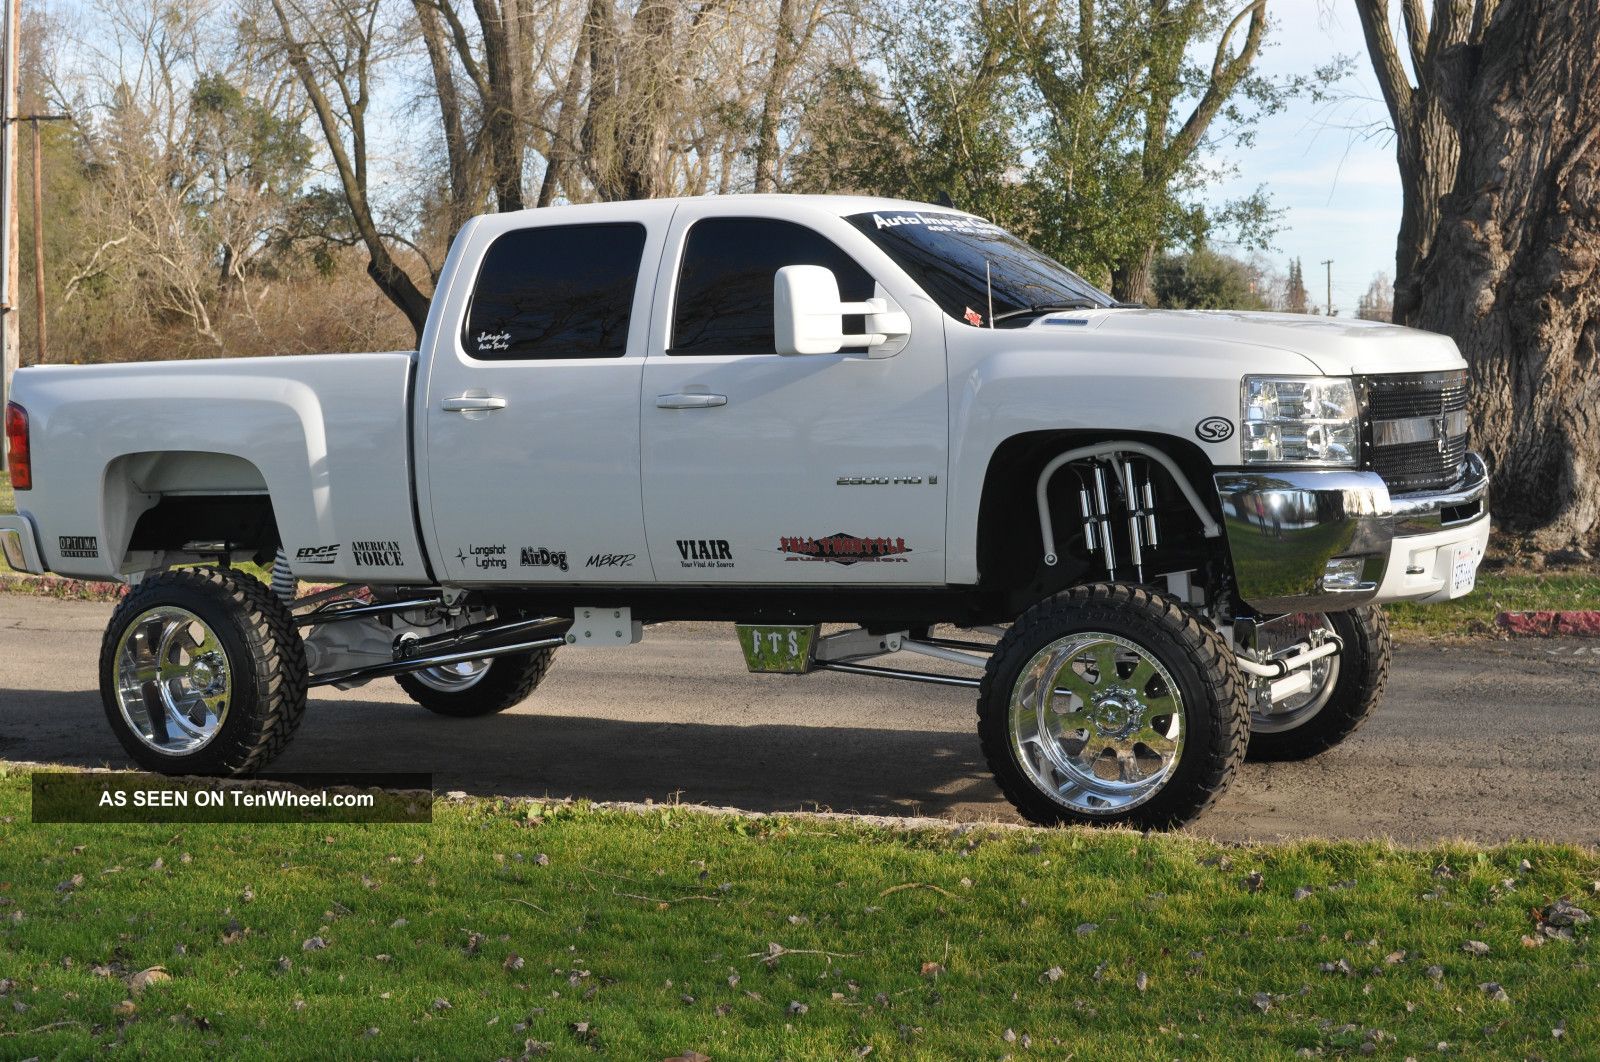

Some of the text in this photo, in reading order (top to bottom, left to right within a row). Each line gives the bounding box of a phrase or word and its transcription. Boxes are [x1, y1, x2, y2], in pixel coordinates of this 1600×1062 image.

[60, 537, 97, 550] OPTIMA
[352, 541, 400, 552] AMERICAN
[676, 539, 733, 560] VIAIR
[297, 544, 340, 558] EDGE
[469, 544, 507, 557] Longshot
[354, 551, 404, 566] FORCE
[476, 556, 507, 569] Lighting
[520, 547, 569, 572] AirDog
[585, 553, 636, 568] MBRP
[707, 560, 716, 568] Air
